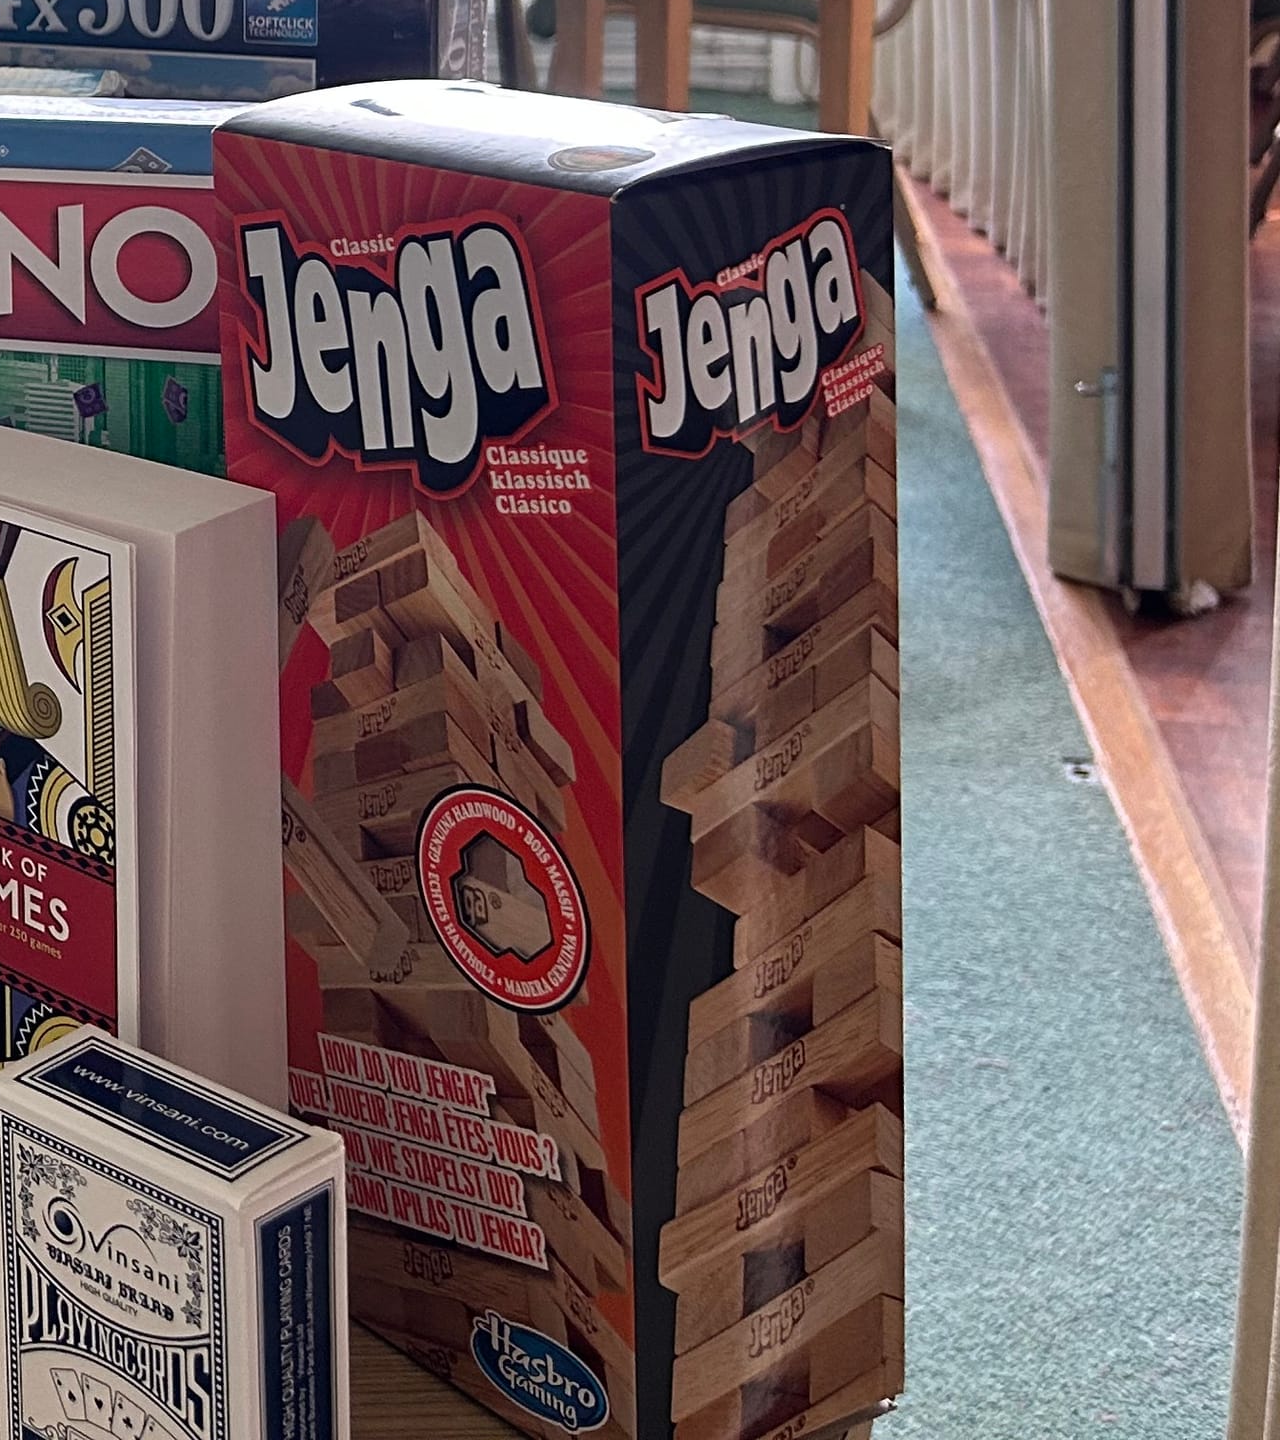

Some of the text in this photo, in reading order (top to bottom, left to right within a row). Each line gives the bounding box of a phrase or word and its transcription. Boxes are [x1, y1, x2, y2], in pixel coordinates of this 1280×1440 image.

[248, 16, 314, 30] SOFTCLICK
[248, 27, 314, 40] TECHNOLOGY
[329, 232, 396, 259] Classic
[716, 252, 766, 288] Classic
[245, 226, 542, 464] Jenga
[645, 219, 857, 439] Jenga
[821, 344, 883, 386] Classique
[823, 360, 885, 402] klassisch
[486, 444, 589, 469] Classique
[489, 468, 590, 492] klassisch
[495, 491, 572, 516] Clásico
[428, 802, 516, 863] GENUINE HARDWOOD
[21, 857, 47, 883] OF
[523, 830, 576, 922] BOIS MASSIF
[9, 926, 27, 943] 250
[29, 937, 62, 960] games
[504, 977, 552, 997] MADERA
[322, 1036, 358, 1077] HOW
[361, 1048, 385, 1084] DO
[385, 1053, 421, 1094] YOU
[73, 1065, 250, 1151] www.vinsani.com
[290, 1072, 329, 1111] QUEL
[331, 1082, 389, 1128] JOUEUR
[392, 1098, 443, 1145] JENGA
[367, 1135, 401, 1176] WIE
[401, 1145, 484, 1201] STAPELST
[487, 1169, 523, 1210] DU?
[278, 1225, 291, 1277] CARDS
[391, 1186, 451, 1235] APILAS
[451, 1204, 476, 1243] TU
[479, 1213, 543, 1263] JENGA?
[88, 1224, 179, 1295] Vinsani
[80, 1280, 138, 1317] HIGH QUALITY
[279, 1278, 293, 1341] PLAYING
[281, 1341, 294, 1402] QUALITY
[477, 1311, 596, 1409] Hasbro
[498, 1355, 577, 1428] Gaming
